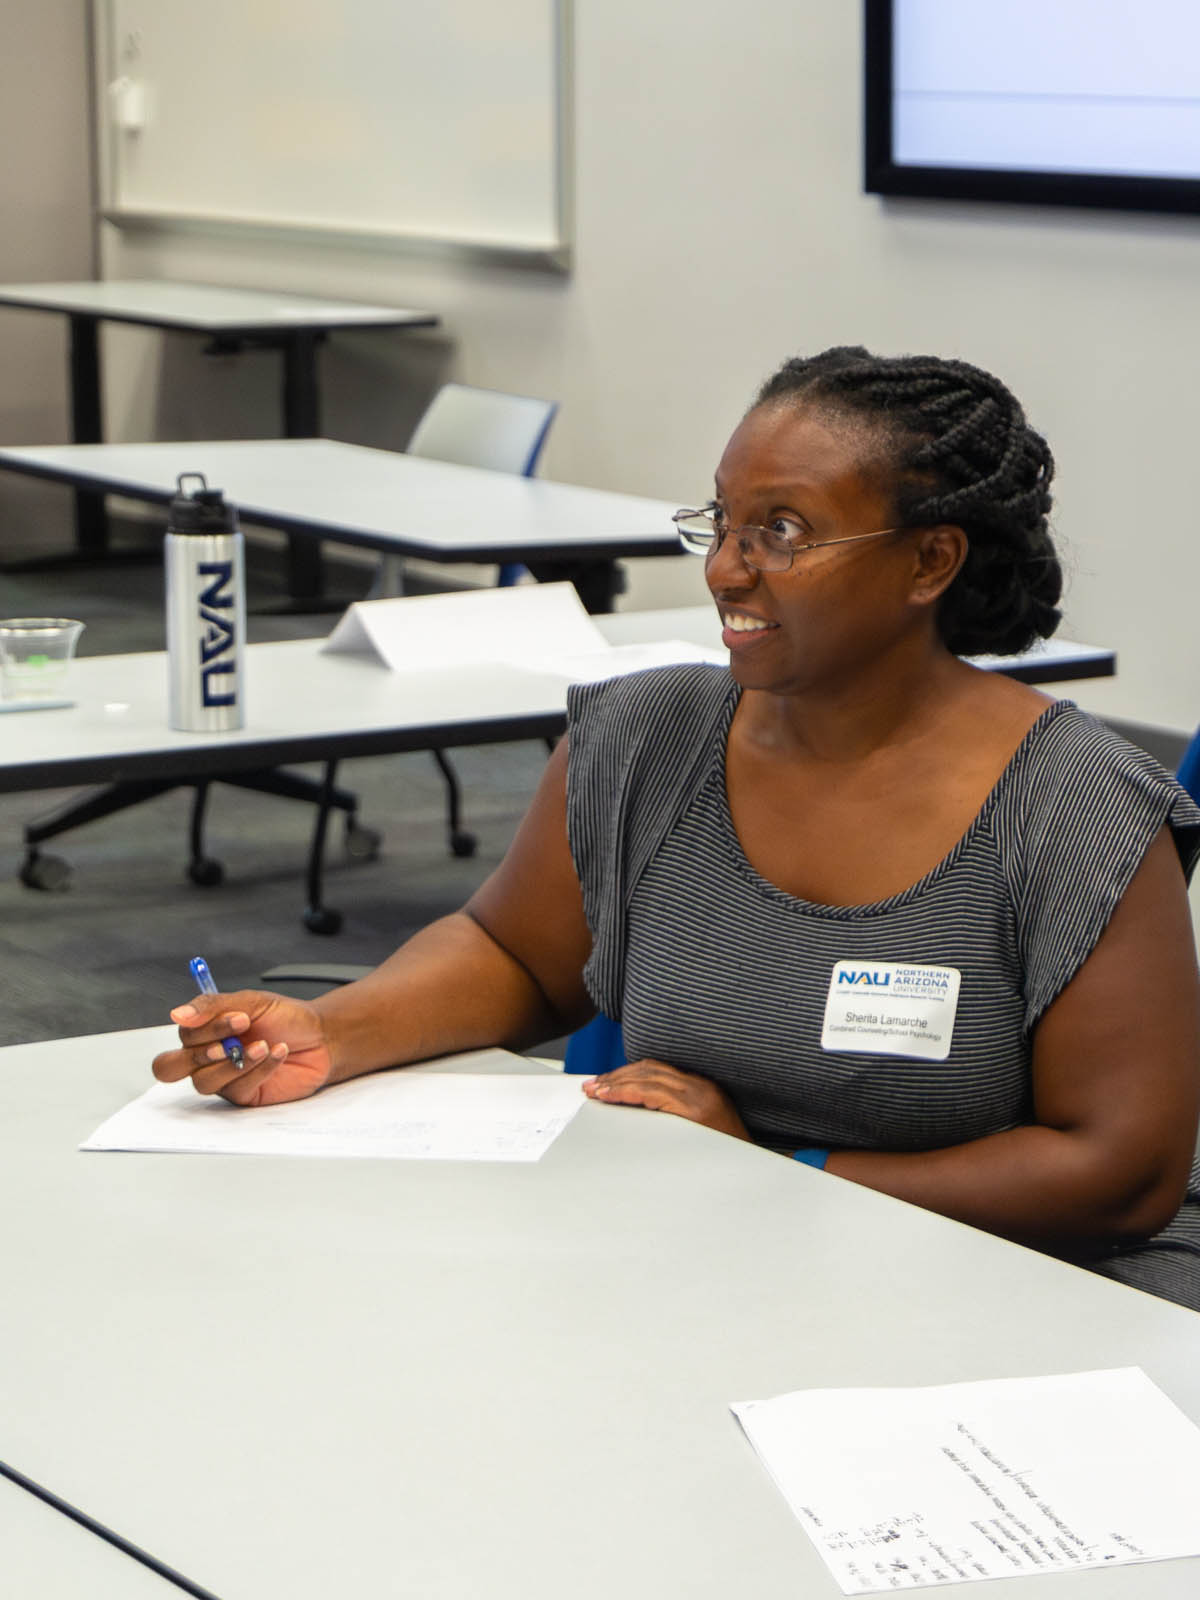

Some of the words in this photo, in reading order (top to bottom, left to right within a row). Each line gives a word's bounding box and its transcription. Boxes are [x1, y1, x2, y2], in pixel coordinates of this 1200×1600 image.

[197, 561, 237, 708] NAU
[838, 971, 890, 986] NAU
[895, 969, 950, 979] NORTHERN
[894, 976, 948, 988] ARIZONA
[893, 985, 948, 995] UNIVERSITY
[845, 1011, 878, 1025] Sherita
[880, 1014, 928, 1029] Lamarche
